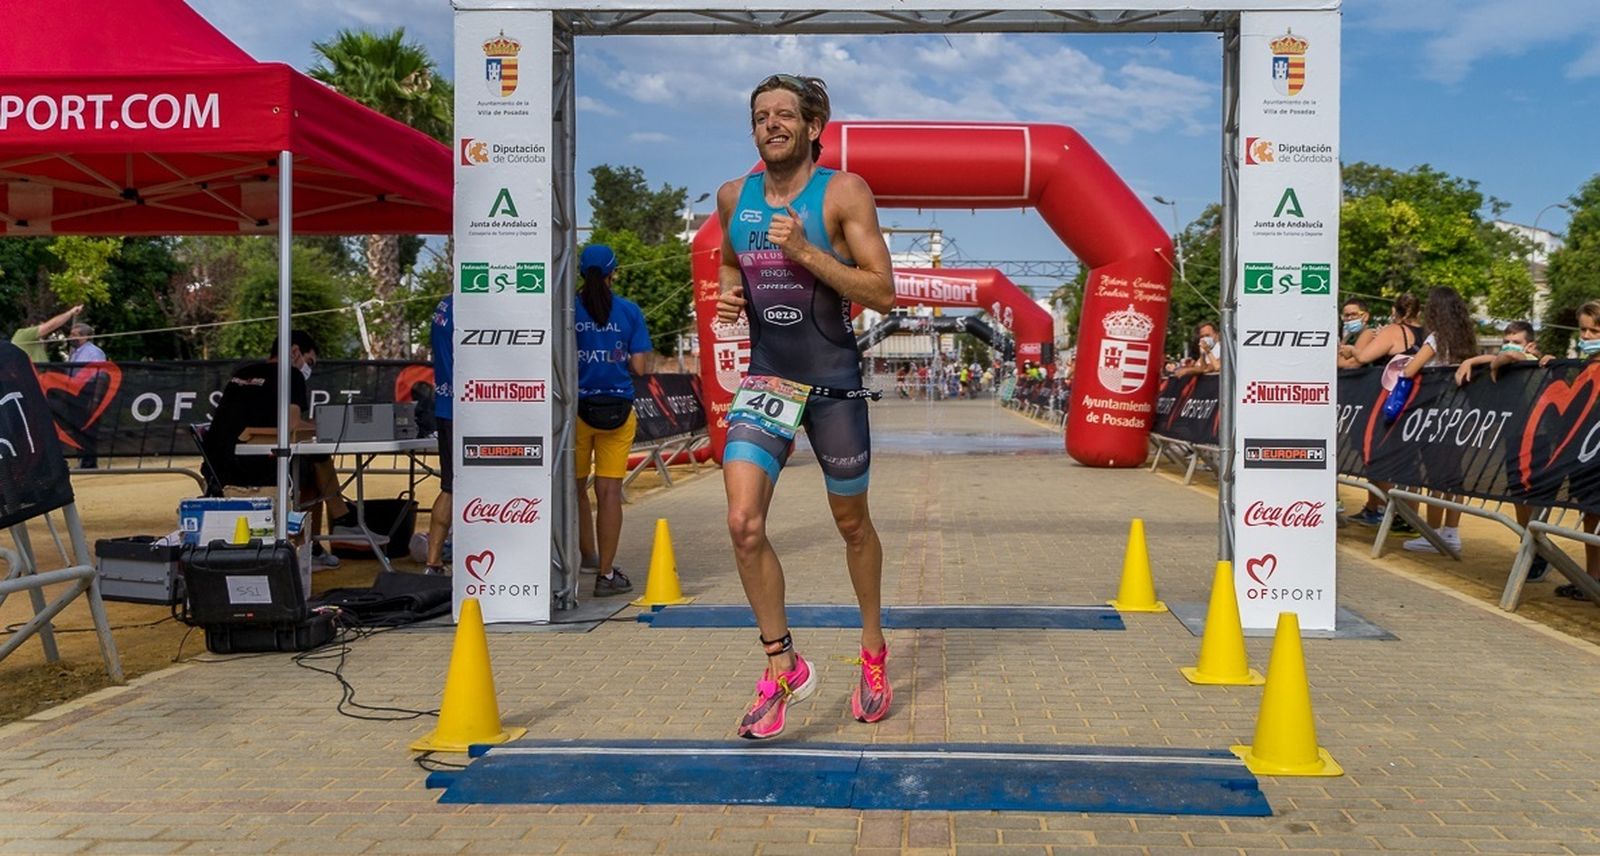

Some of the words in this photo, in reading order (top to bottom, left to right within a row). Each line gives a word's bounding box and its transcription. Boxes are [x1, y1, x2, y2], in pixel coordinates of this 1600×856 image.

[1, 93, 220, 131] PORT.COM
[493, 144, 546, 154] Diputación
[1278, 144, 1332, 153] Diputación
[493, 154, 505, 163] de
[507, 154, 546, 163] Córdoba
[1278, 154, 1291, 162] de
[1293, 154, 1333, 162] Córdoba
[501, 220, 538, 228] Andalucía
[1286, 220, 1323, 228] Andalucía
[461, 329, 545, 346] ZONE3
[1242, 330, 1331, 347] ZONE3
[474, 382, 545, 401] NutriSport
[1257, 384, 1330, 404] NutriSport
[746, 393, 784, 418] 40
[1082, 394, 1152, 413] Ayuntamiento
[1086, 412, 1100, 423] de
[1102, 413, 1145, 428] Posadas
[1402, 408, 1513, 450] OFSPORT
[466, 584, 540, 596] OFSPORT
[1247, 588, 1323, 601] OFSPORT
